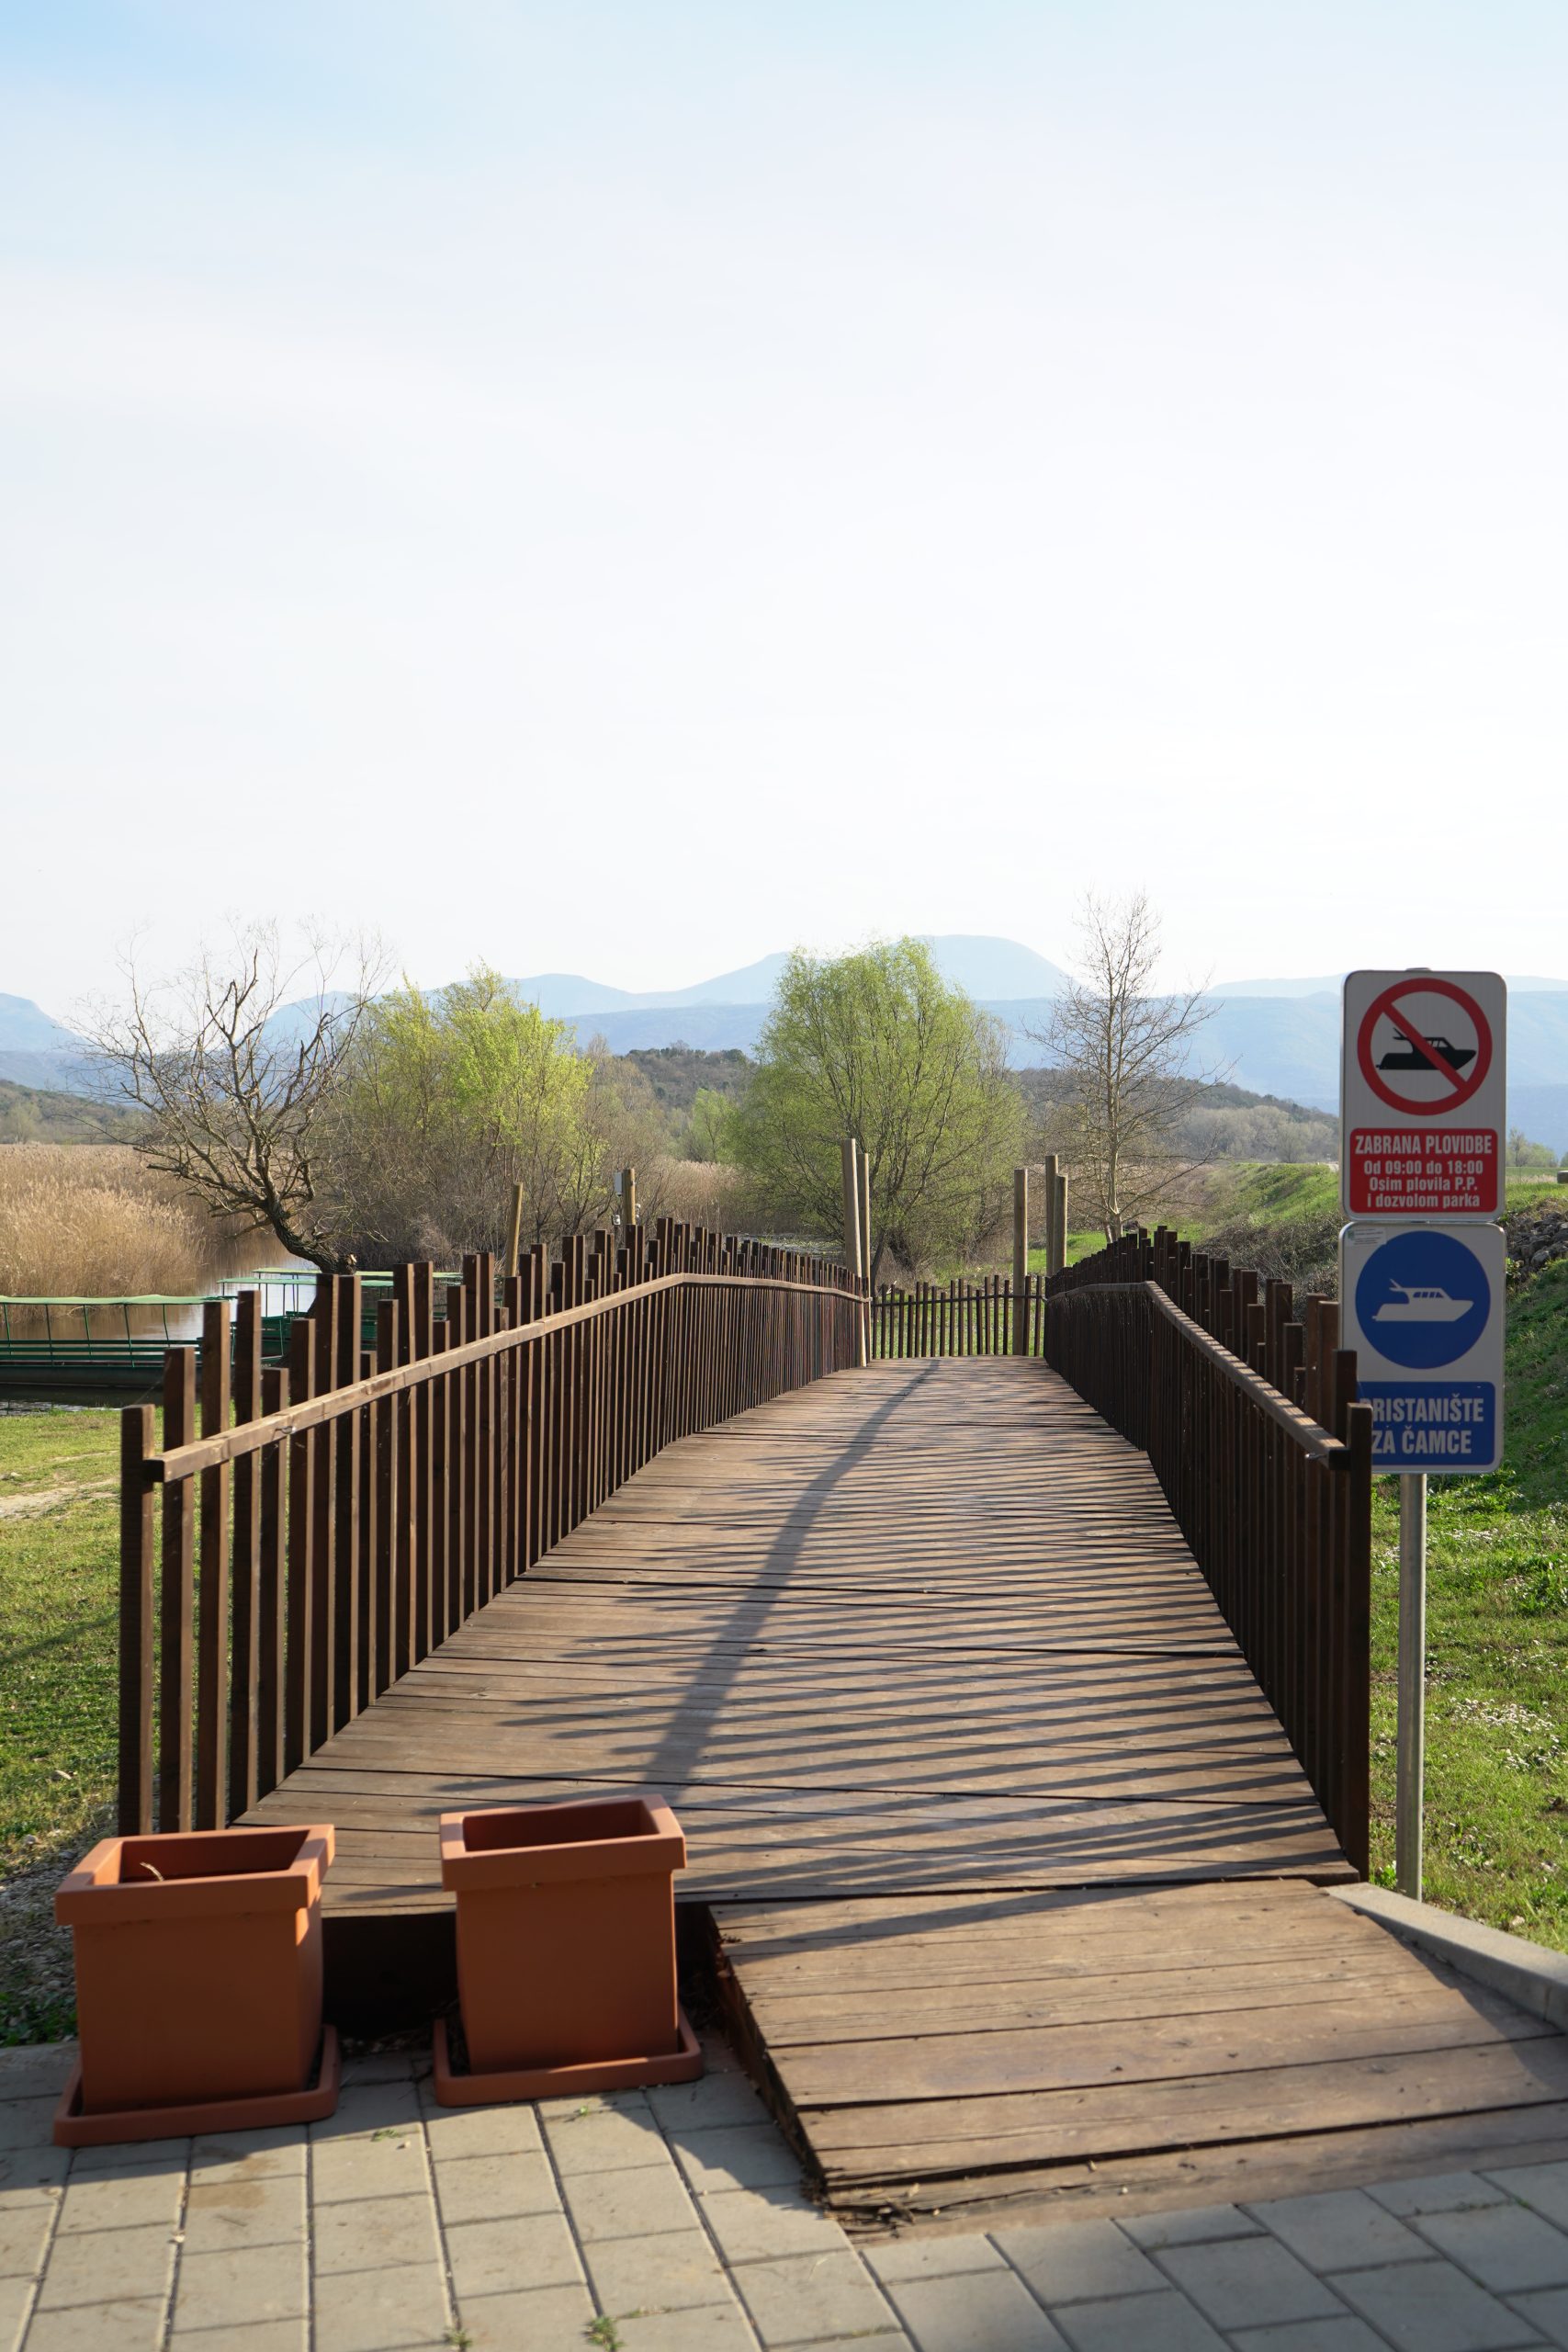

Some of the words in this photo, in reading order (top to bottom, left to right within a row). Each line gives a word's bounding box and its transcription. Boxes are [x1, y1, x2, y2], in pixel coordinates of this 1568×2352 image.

[1355, 1135, 1421, 1154] ZABRANA
[1426, 1135, 1492, 1154] PLOVIDBE
[1364, 1160, 1381, 1174] Od
[1385, 1160, 1422, 1174] 09:00
[1426, 1160, 1442, 1174] do
[1448, 1160, 1483, 1174] 18:00
[1370, 1177, 1402, 1191] Osim
[1406, 1177, 1450, 1193] plovila
[1455, 1177, 1477, 1191] P.P.
[1367, 1193, 1371, 1207] i
[1375, 1193, 1438, 1207] dozvolom
[1443, 1193, 1480, 1209] parka
[1359, 1393, 1484, 1422] RISTANIŠTE
[1371, 1430, 1395, 1453] ZA
[1402, 1425, 1472, 1454] ČAMCE
